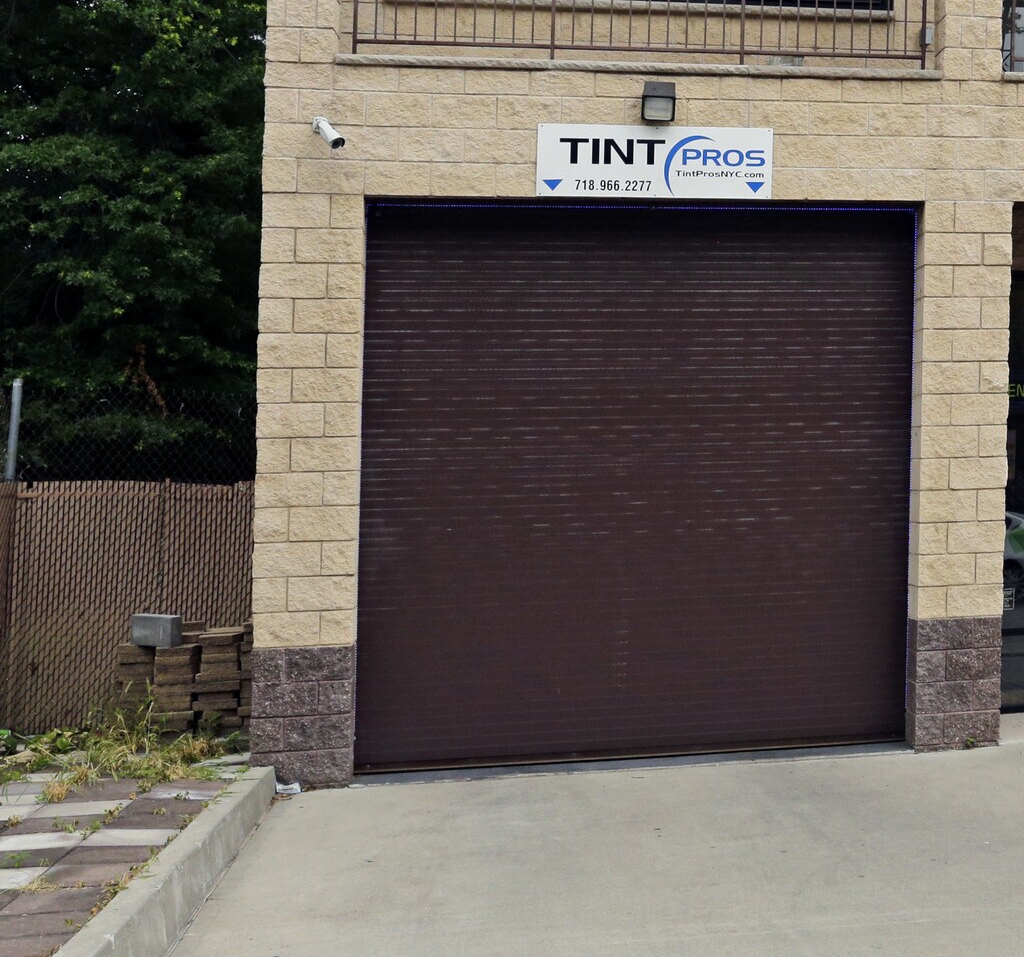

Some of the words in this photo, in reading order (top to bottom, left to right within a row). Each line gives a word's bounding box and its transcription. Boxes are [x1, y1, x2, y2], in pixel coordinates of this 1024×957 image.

[559, 138, 666, 165] TINT
[681, 148, 766, 167] PROS
[675, 170, 765, 179] TintProsNYC.com
[574, 179, 652, 192] 718.966.2277
